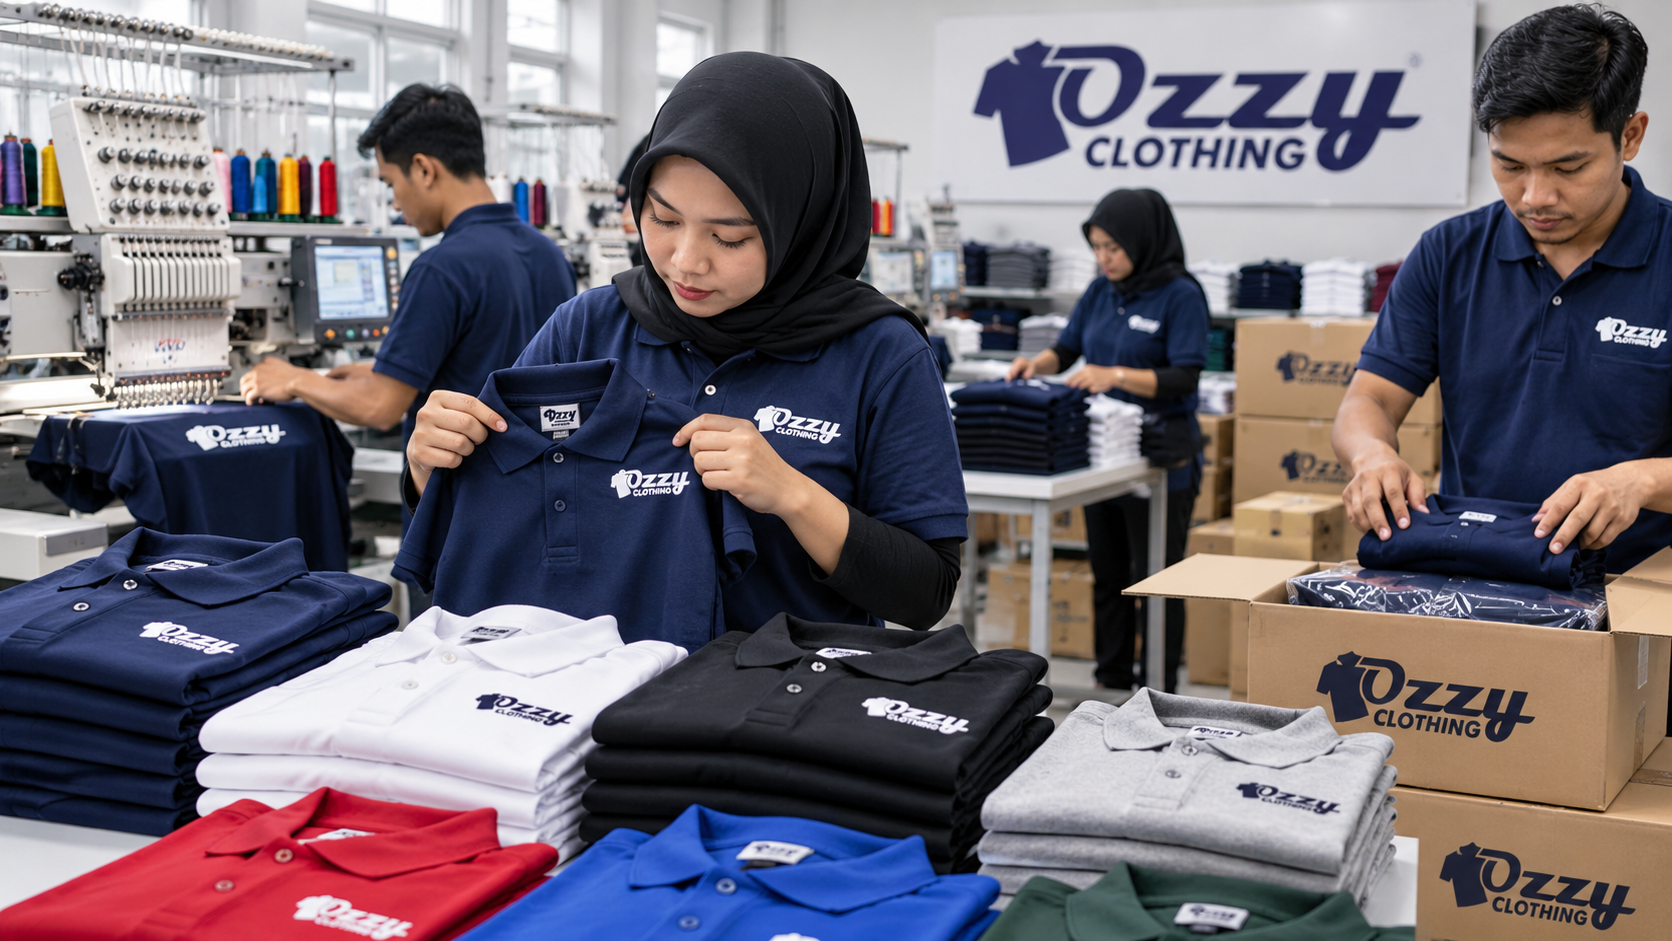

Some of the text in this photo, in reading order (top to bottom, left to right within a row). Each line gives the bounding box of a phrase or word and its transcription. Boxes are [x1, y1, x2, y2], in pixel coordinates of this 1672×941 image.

[1052, 44, 1422, 172] Ozzy
[1085, 136, 1307, 171] CLOTHING
[1611, 317, 1668, 349] Ozzy
[204, 423, 287, 445] Ozzy
[772, 407, 842, 444] Ozzy
[775, 426, 819, 441] CLOTHING
[625, 468, 691, 496] Ozzy
[161, 623, 240, 655] Ozzy
[495, 694, 574, 726] Ozzy
[1359, 656, 1536, 743] Ozzy
[884, 699, 970, 735] Ozzy
[1373, 708, 1482, 739] CLOTHING
[1258, 783, 1342, 815] Ozzy
[1478, 847, 1637, 931] Ozzy
[319, 897, 414, 941] Ozzy
[1491, 895, 1588, 926] CLOTHING
